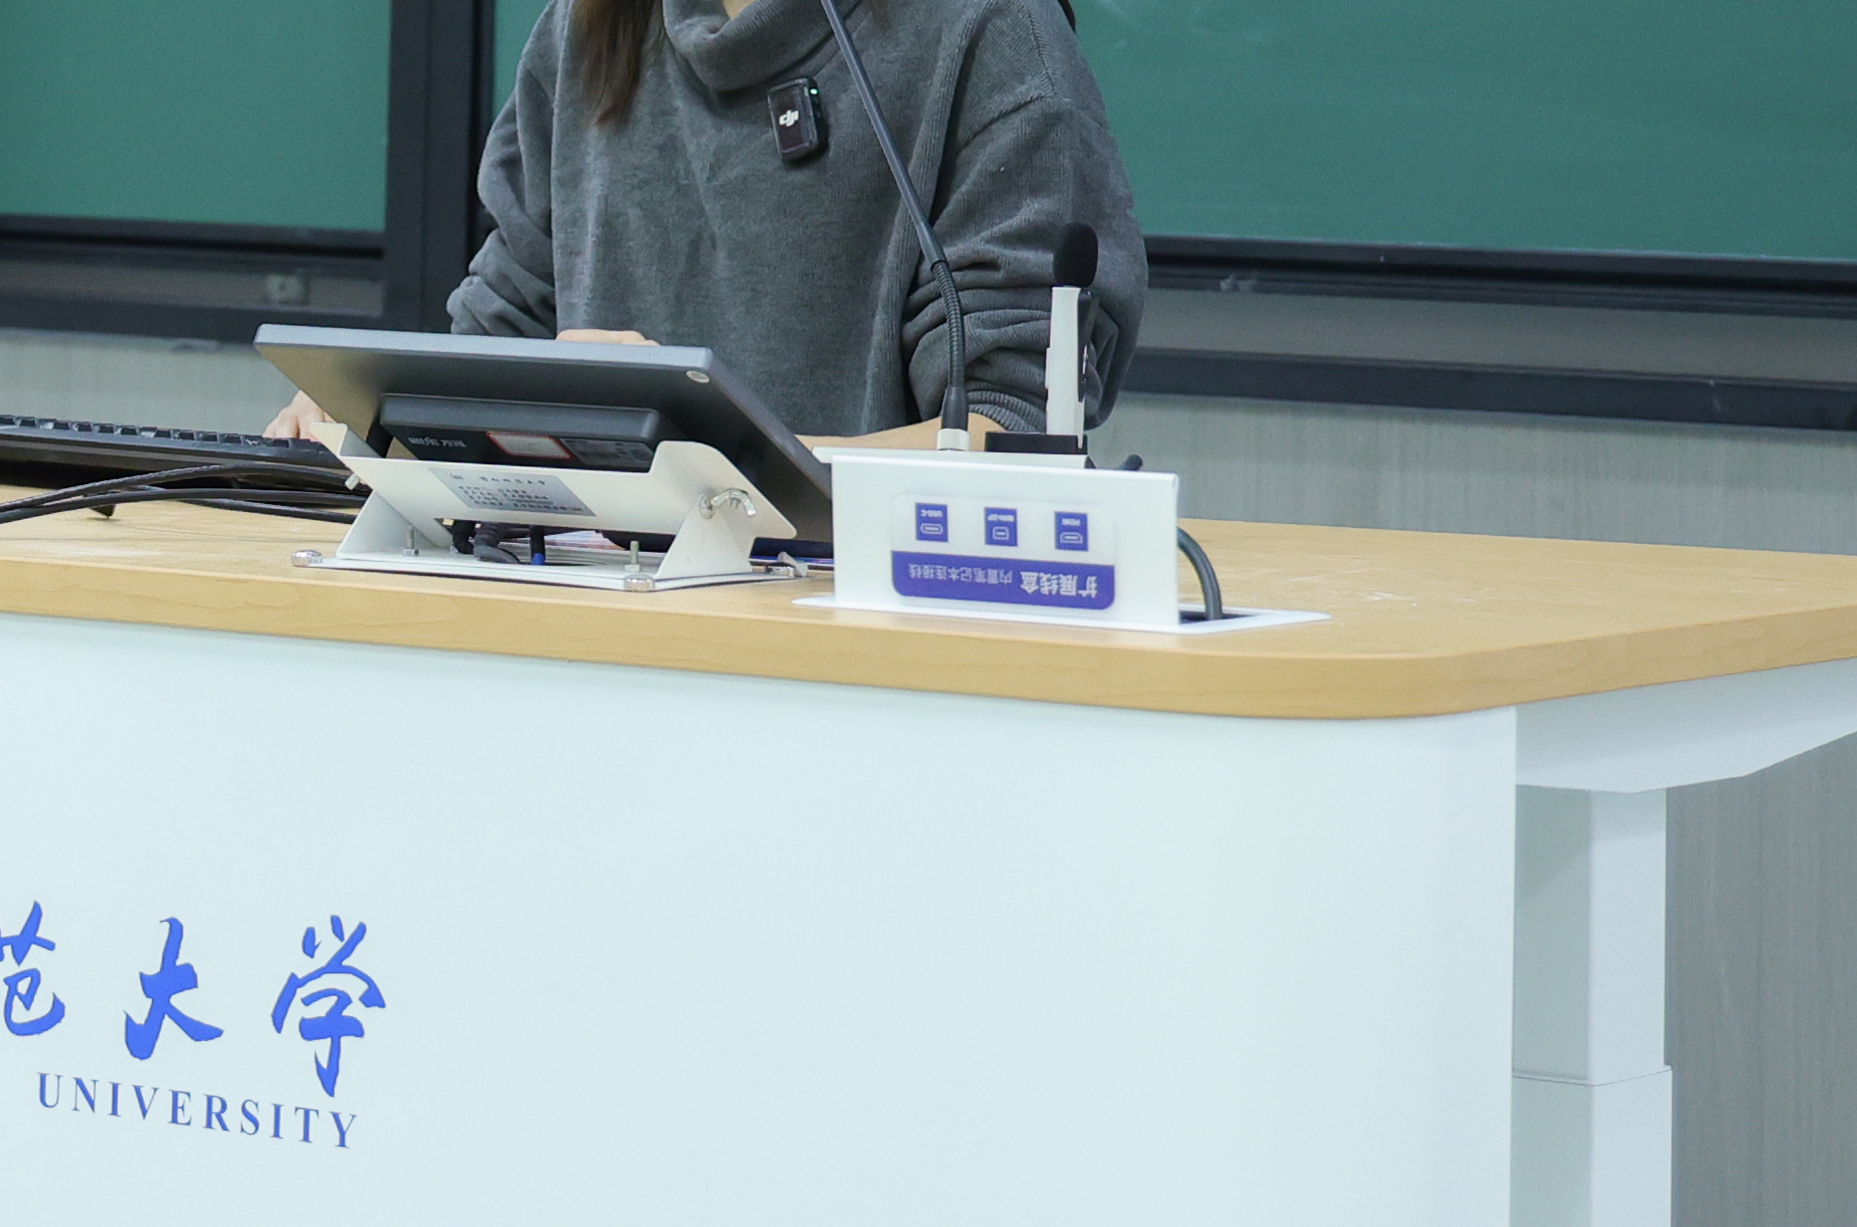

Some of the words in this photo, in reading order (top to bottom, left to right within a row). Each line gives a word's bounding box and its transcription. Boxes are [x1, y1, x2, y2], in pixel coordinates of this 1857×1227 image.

[908, 563, 1013, 585] 内置笔记本连接线
[1020, 571, 1099, 599] 扩展线盒
[36, 1071, 358, 1150] UNIVERSITY
